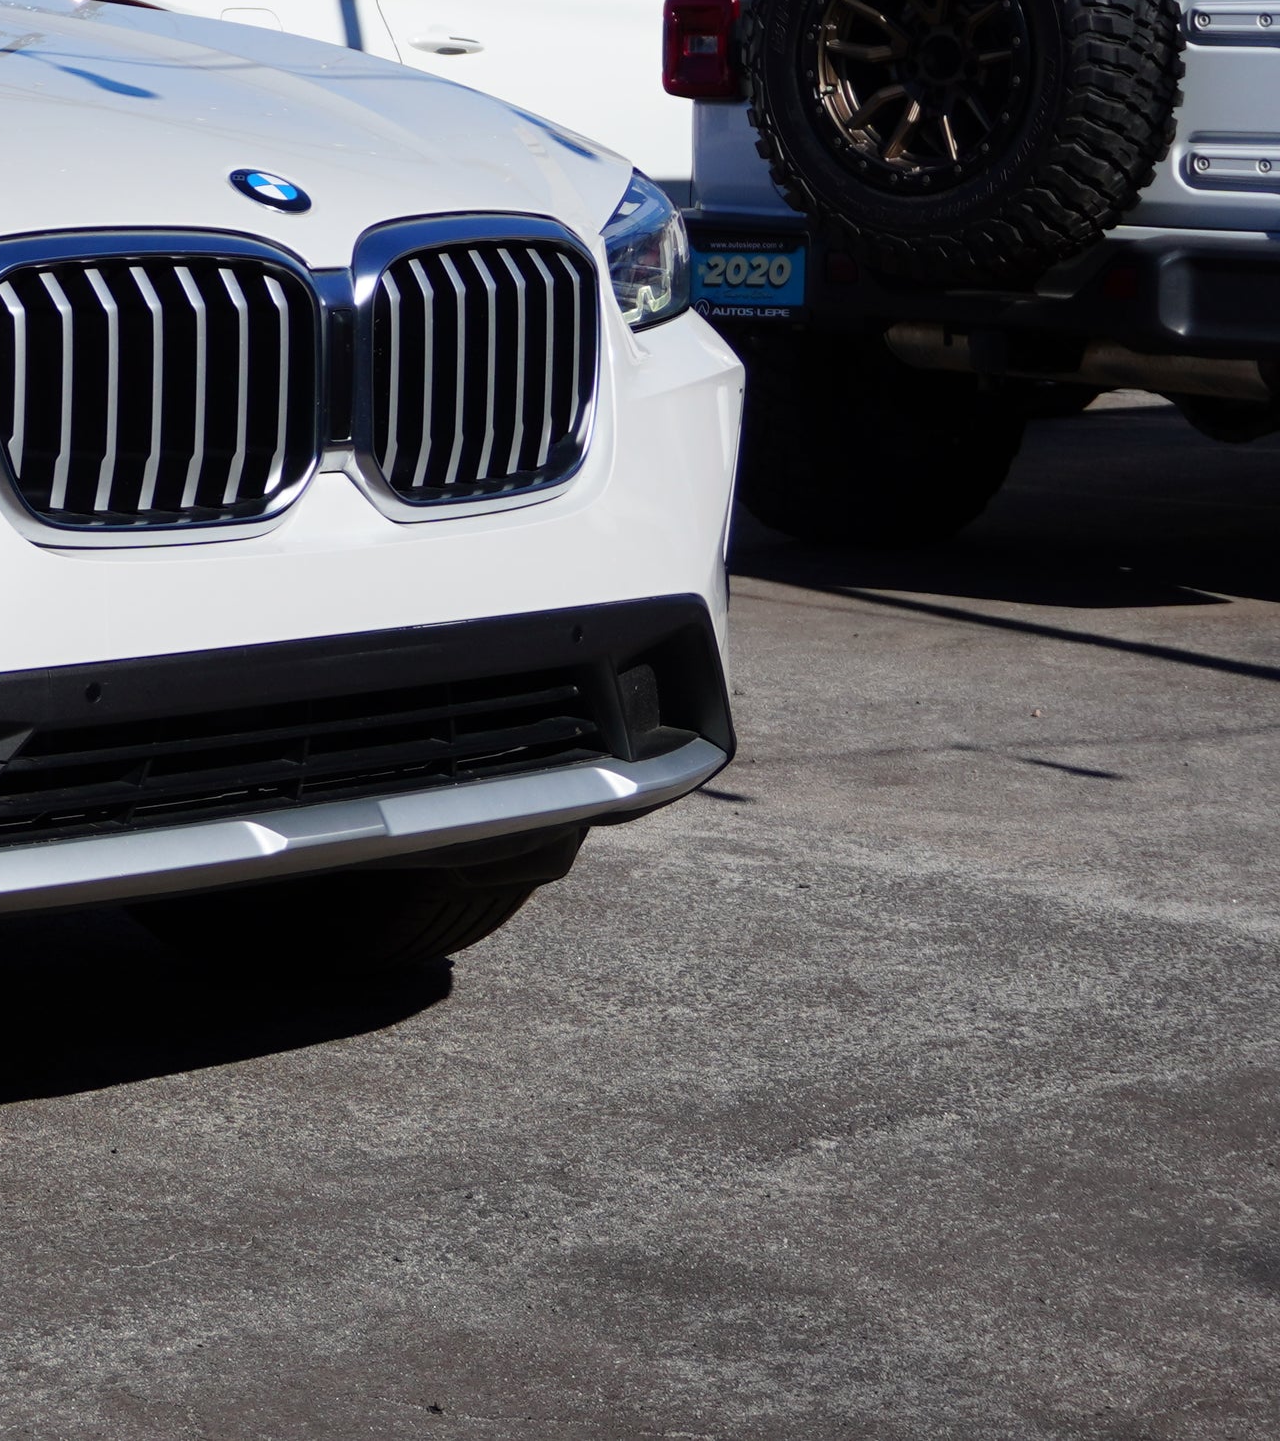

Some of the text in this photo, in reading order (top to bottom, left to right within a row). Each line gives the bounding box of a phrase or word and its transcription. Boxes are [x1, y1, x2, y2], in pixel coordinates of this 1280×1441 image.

[703, 255, 792, 287] 2020
[711, 307, 791, 318] AUTOS LEPE
